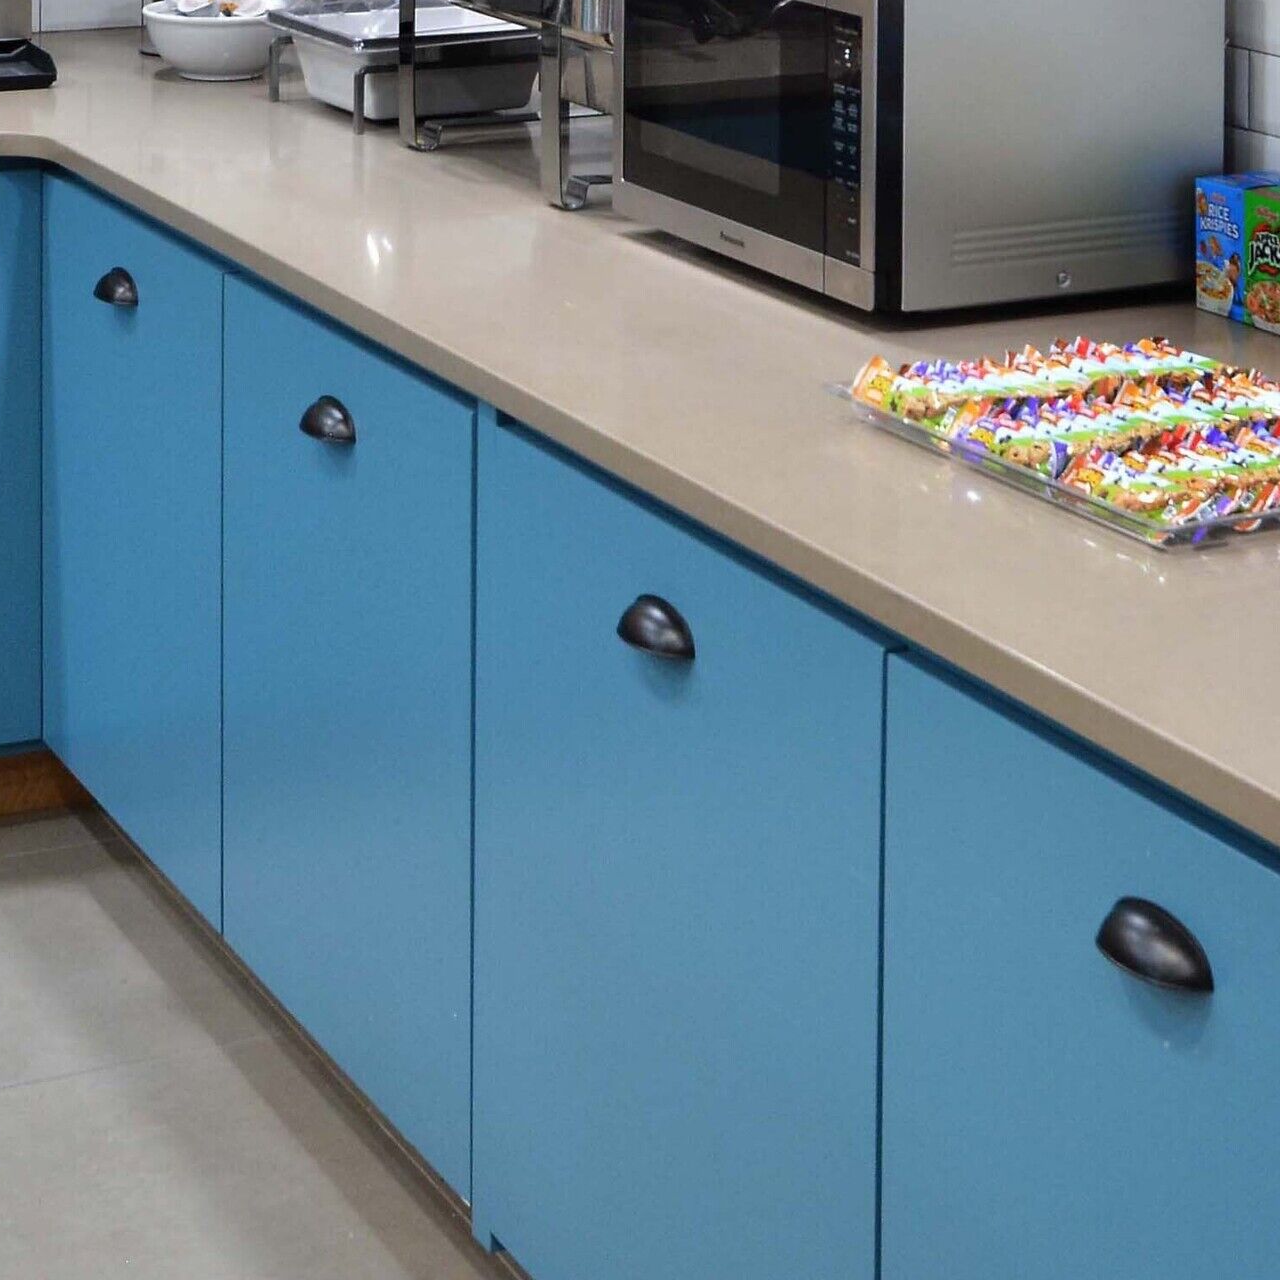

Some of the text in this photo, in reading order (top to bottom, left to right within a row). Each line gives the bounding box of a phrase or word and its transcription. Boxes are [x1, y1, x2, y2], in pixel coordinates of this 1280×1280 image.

[1208, 203, 1230, 222] RICE
[1200, 217, 1240, 239] KRISPIES
[1256, 232, 1280, 247] APPLE
